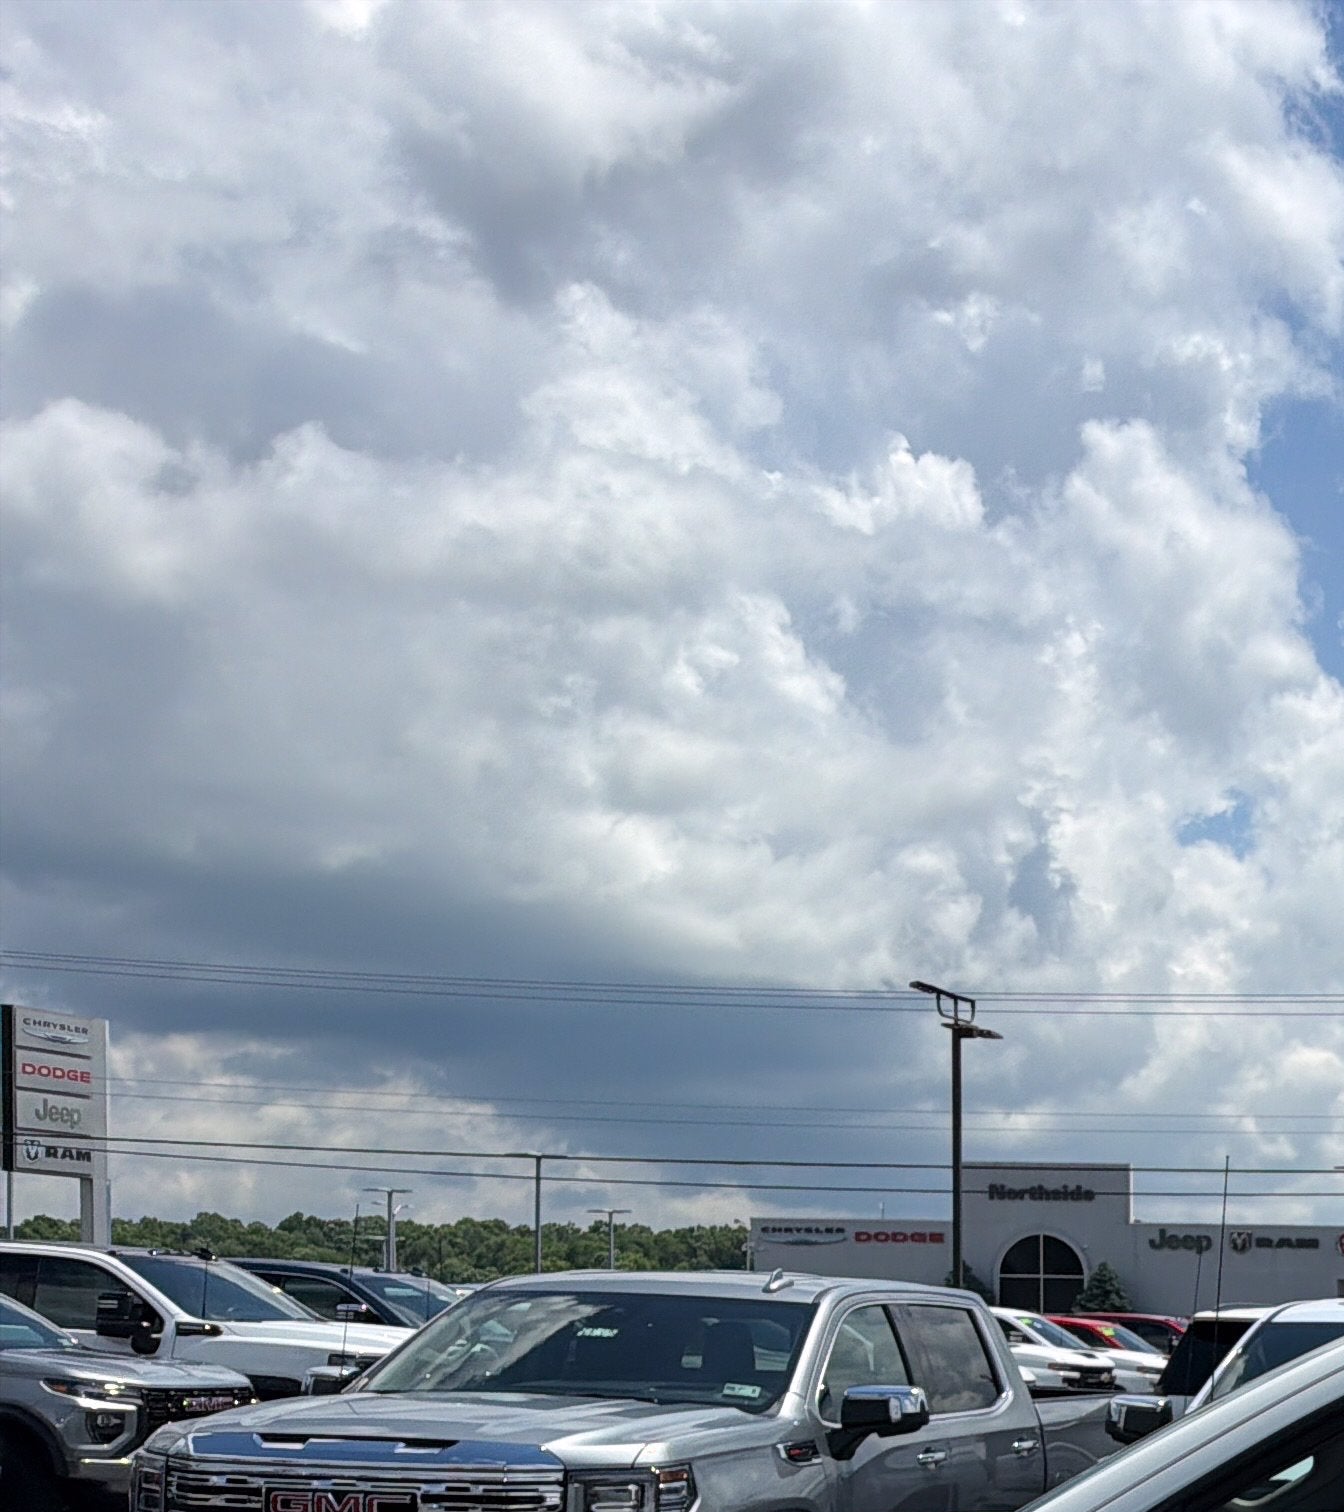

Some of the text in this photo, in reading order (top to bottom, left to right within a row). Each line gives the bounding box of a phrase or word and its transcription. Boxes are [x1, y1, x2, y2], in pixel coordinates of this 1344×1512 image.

[22, 1017, 89, 1035] CHRYSLER
[21, 1062, 91, 1084] DODGE
[34, 1098, 82, 1129] Jeep
[44, 1145, 92, 1163] RAM
[988, 1184, 1095, 1201] Northside
[760, 1226, 846, 1234] CHRYSLER
[854, 1231, 945, 1244] DODGE
[1148, 1228, 1213, 1255] Jeep
[1254, 1236, 1320, 1249] RAM
